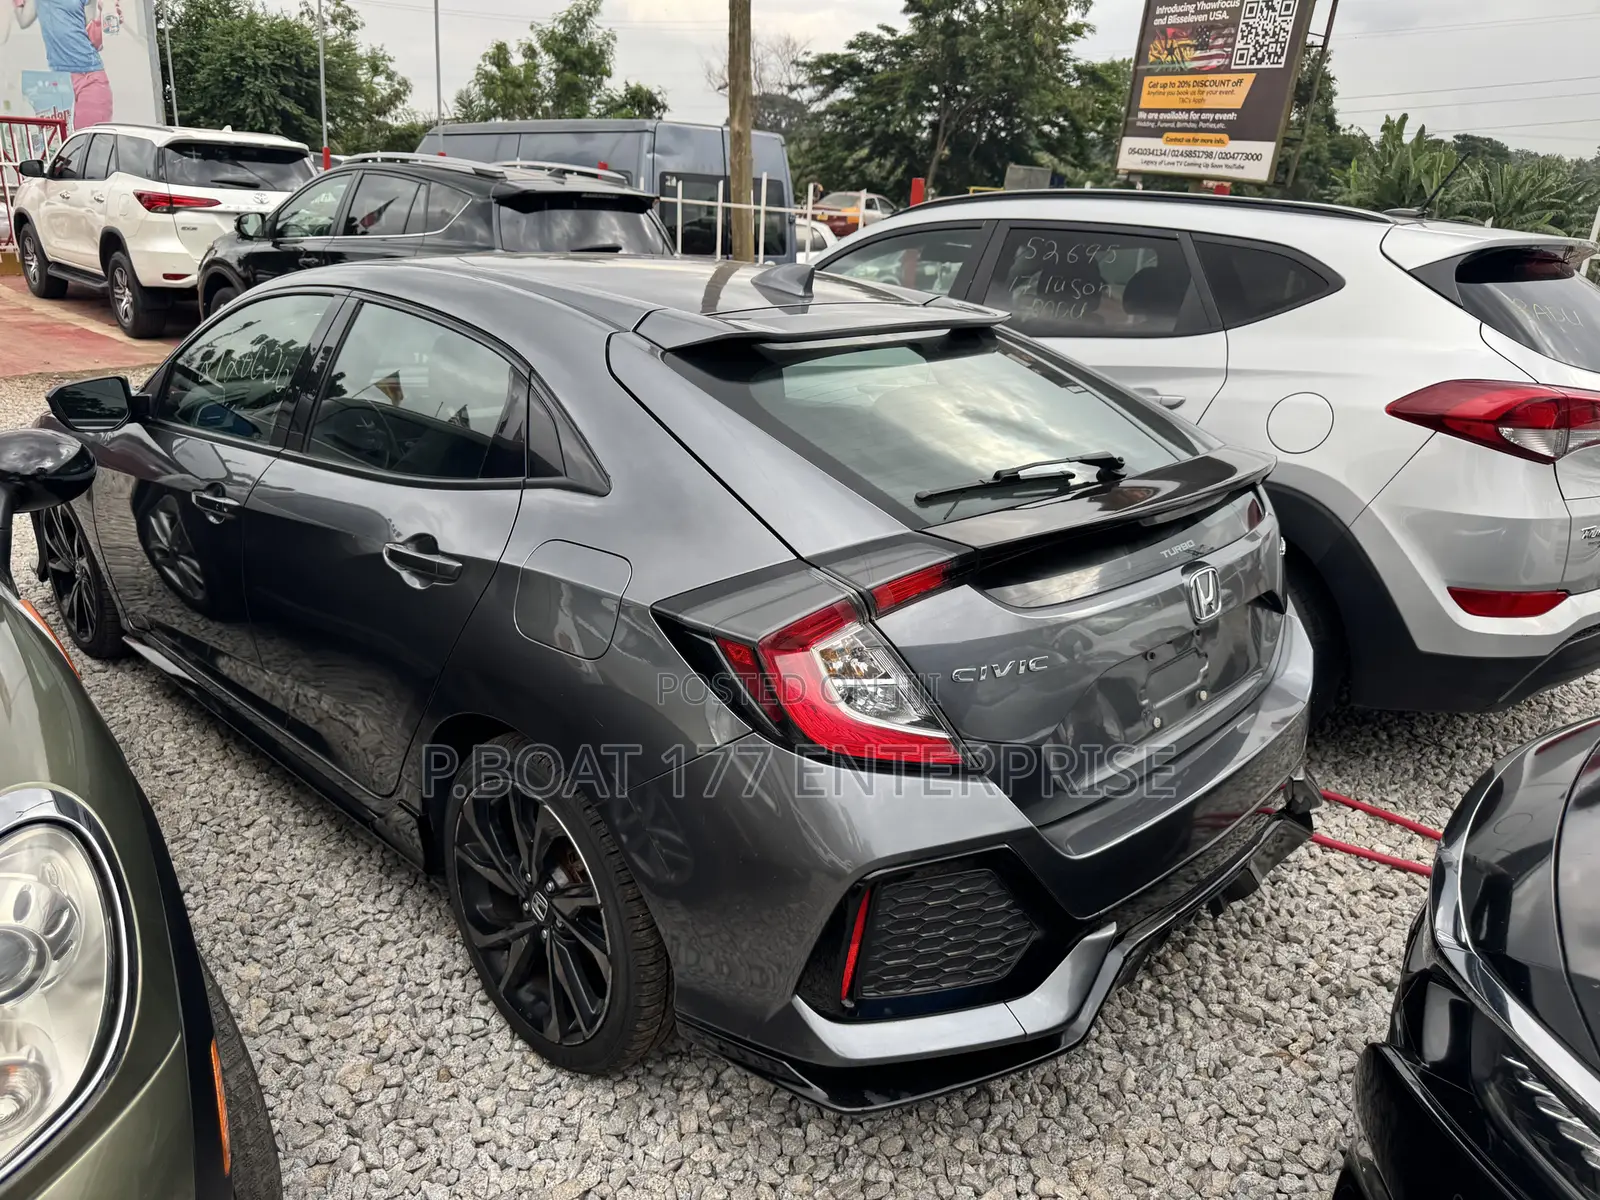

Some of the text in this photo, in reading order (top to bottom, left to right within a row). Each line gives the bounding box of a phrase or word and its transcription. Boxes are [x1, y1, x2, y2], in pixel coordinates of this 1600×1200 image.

[1156, 3, 1196, 15] Introducing
[1154, 11, 1229, 25] and Blisseleven USA.
[1148, 81, 1159, 89] Get
[1193, 79, 1231, 88] DISCOUNT
[1232, 78, 1244, 87] off
[1138, 111, 1146, 119] We
[1159, 111, 1189, 120] available
[1190, 112, 1200, 120] for
[1218, 152, 1262, 162] 0204773000
[1024, 236, 1120, 265] 52695
[1160, 539, 1196, 558] TURBO
[950, 655, 1049, 683] CIVIC
